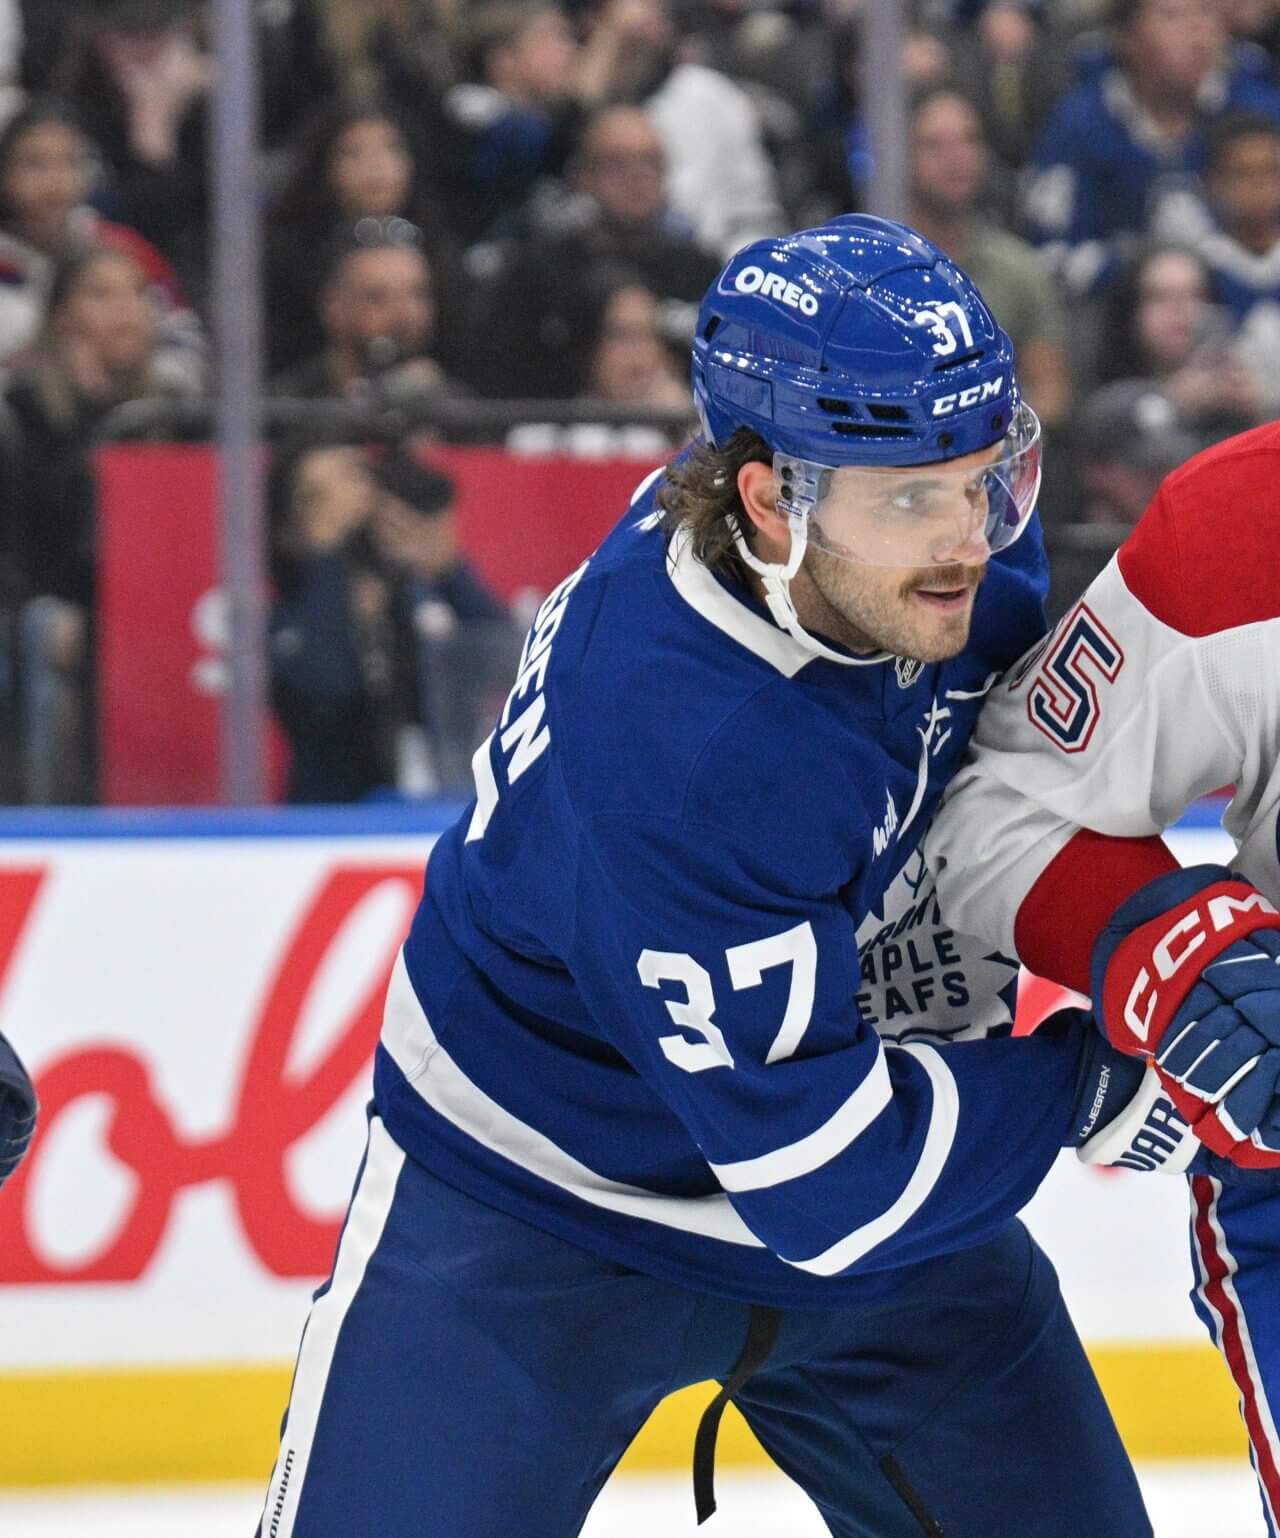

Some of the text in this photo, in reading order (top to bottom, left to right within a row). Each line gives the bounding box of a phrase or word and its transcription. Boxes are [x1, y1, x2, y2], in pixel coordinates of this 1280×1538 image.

[734, 265, 819, 317] OREO
[914, 301, 974, 356] 37
[931, 376, 1003, 417] CCM
[859, 930, 962, 985] APLE
[1124, 893, 1280, 1042] CCM
[636, 920, 818, 1073] 37
[856, 971, 970, 1024] EAFS
